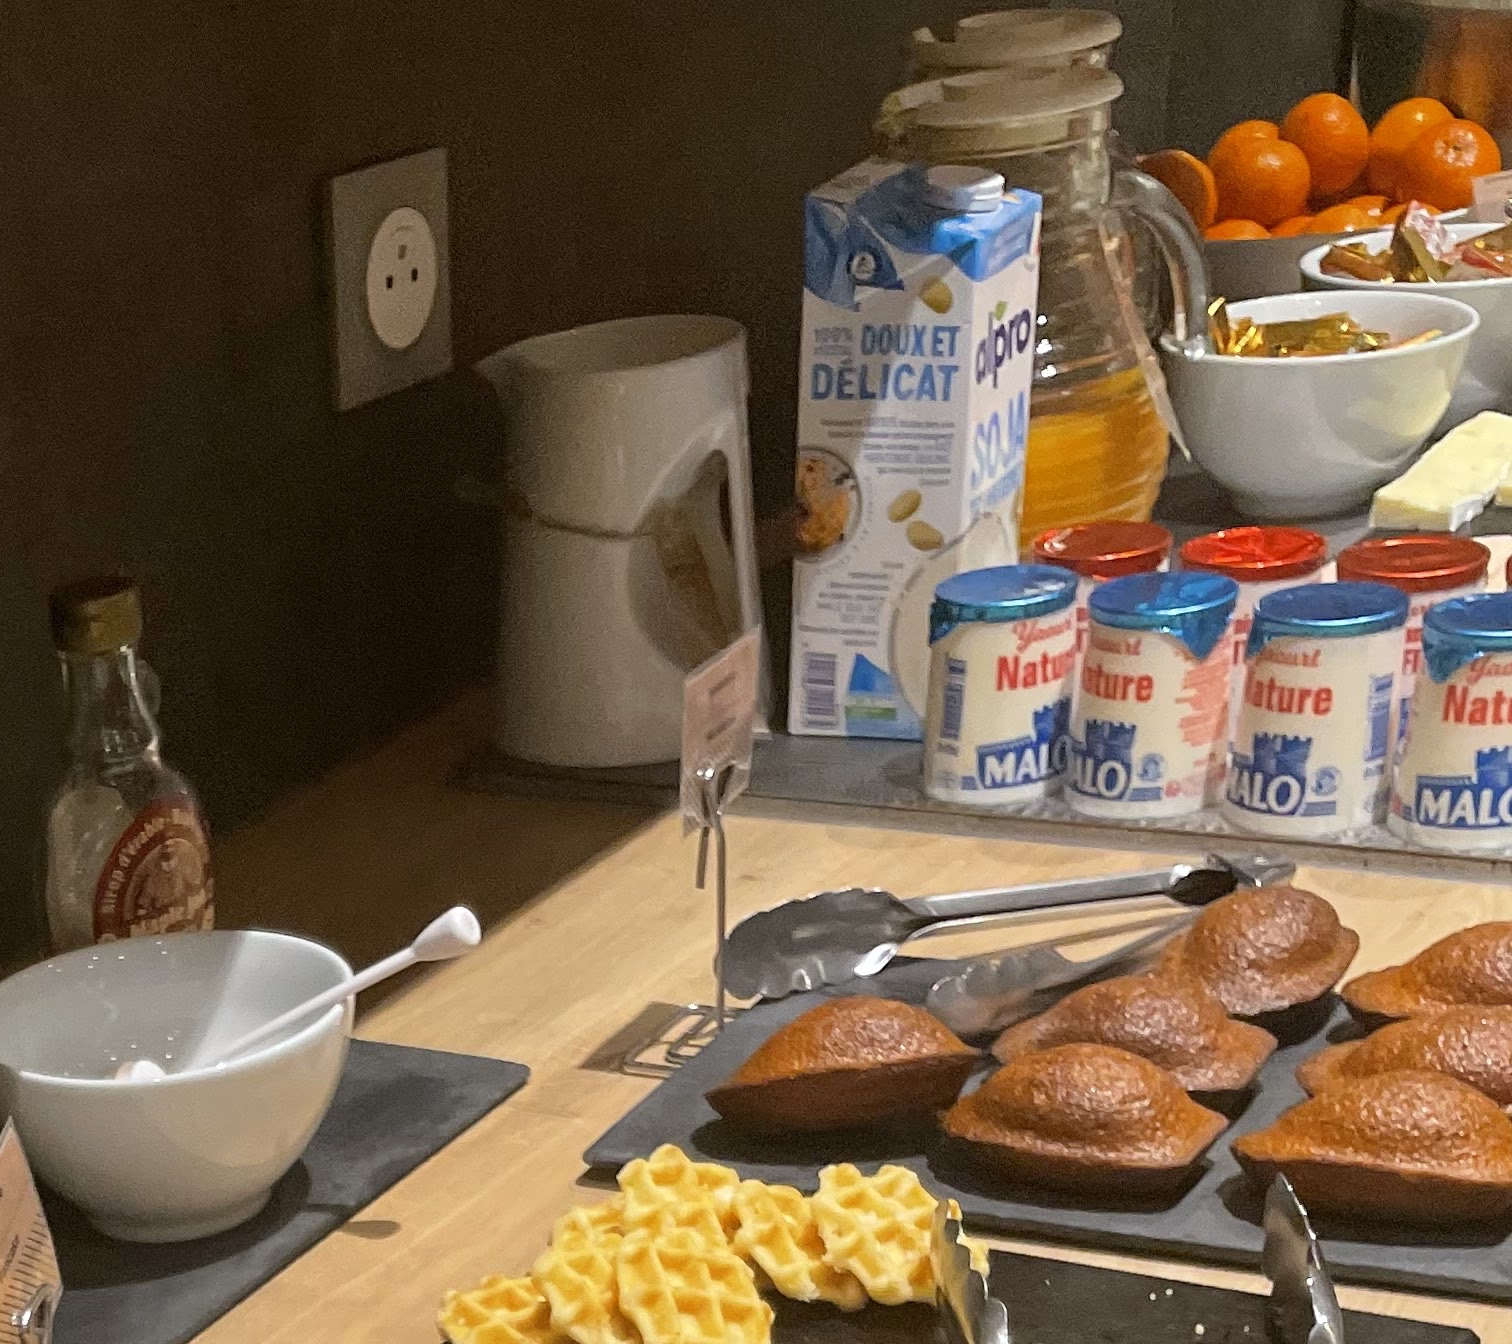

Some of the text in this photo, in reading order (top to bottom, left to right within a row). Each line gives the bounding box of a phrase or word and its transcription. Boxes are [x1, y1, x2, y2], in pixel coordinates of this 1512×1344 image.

[861, 323, 926, 357] DOUX
[932, 325, 961, 357] ET
[975, 309, 1031, 388] alpro
[810, 357, 959, 402] DÉLICAT
